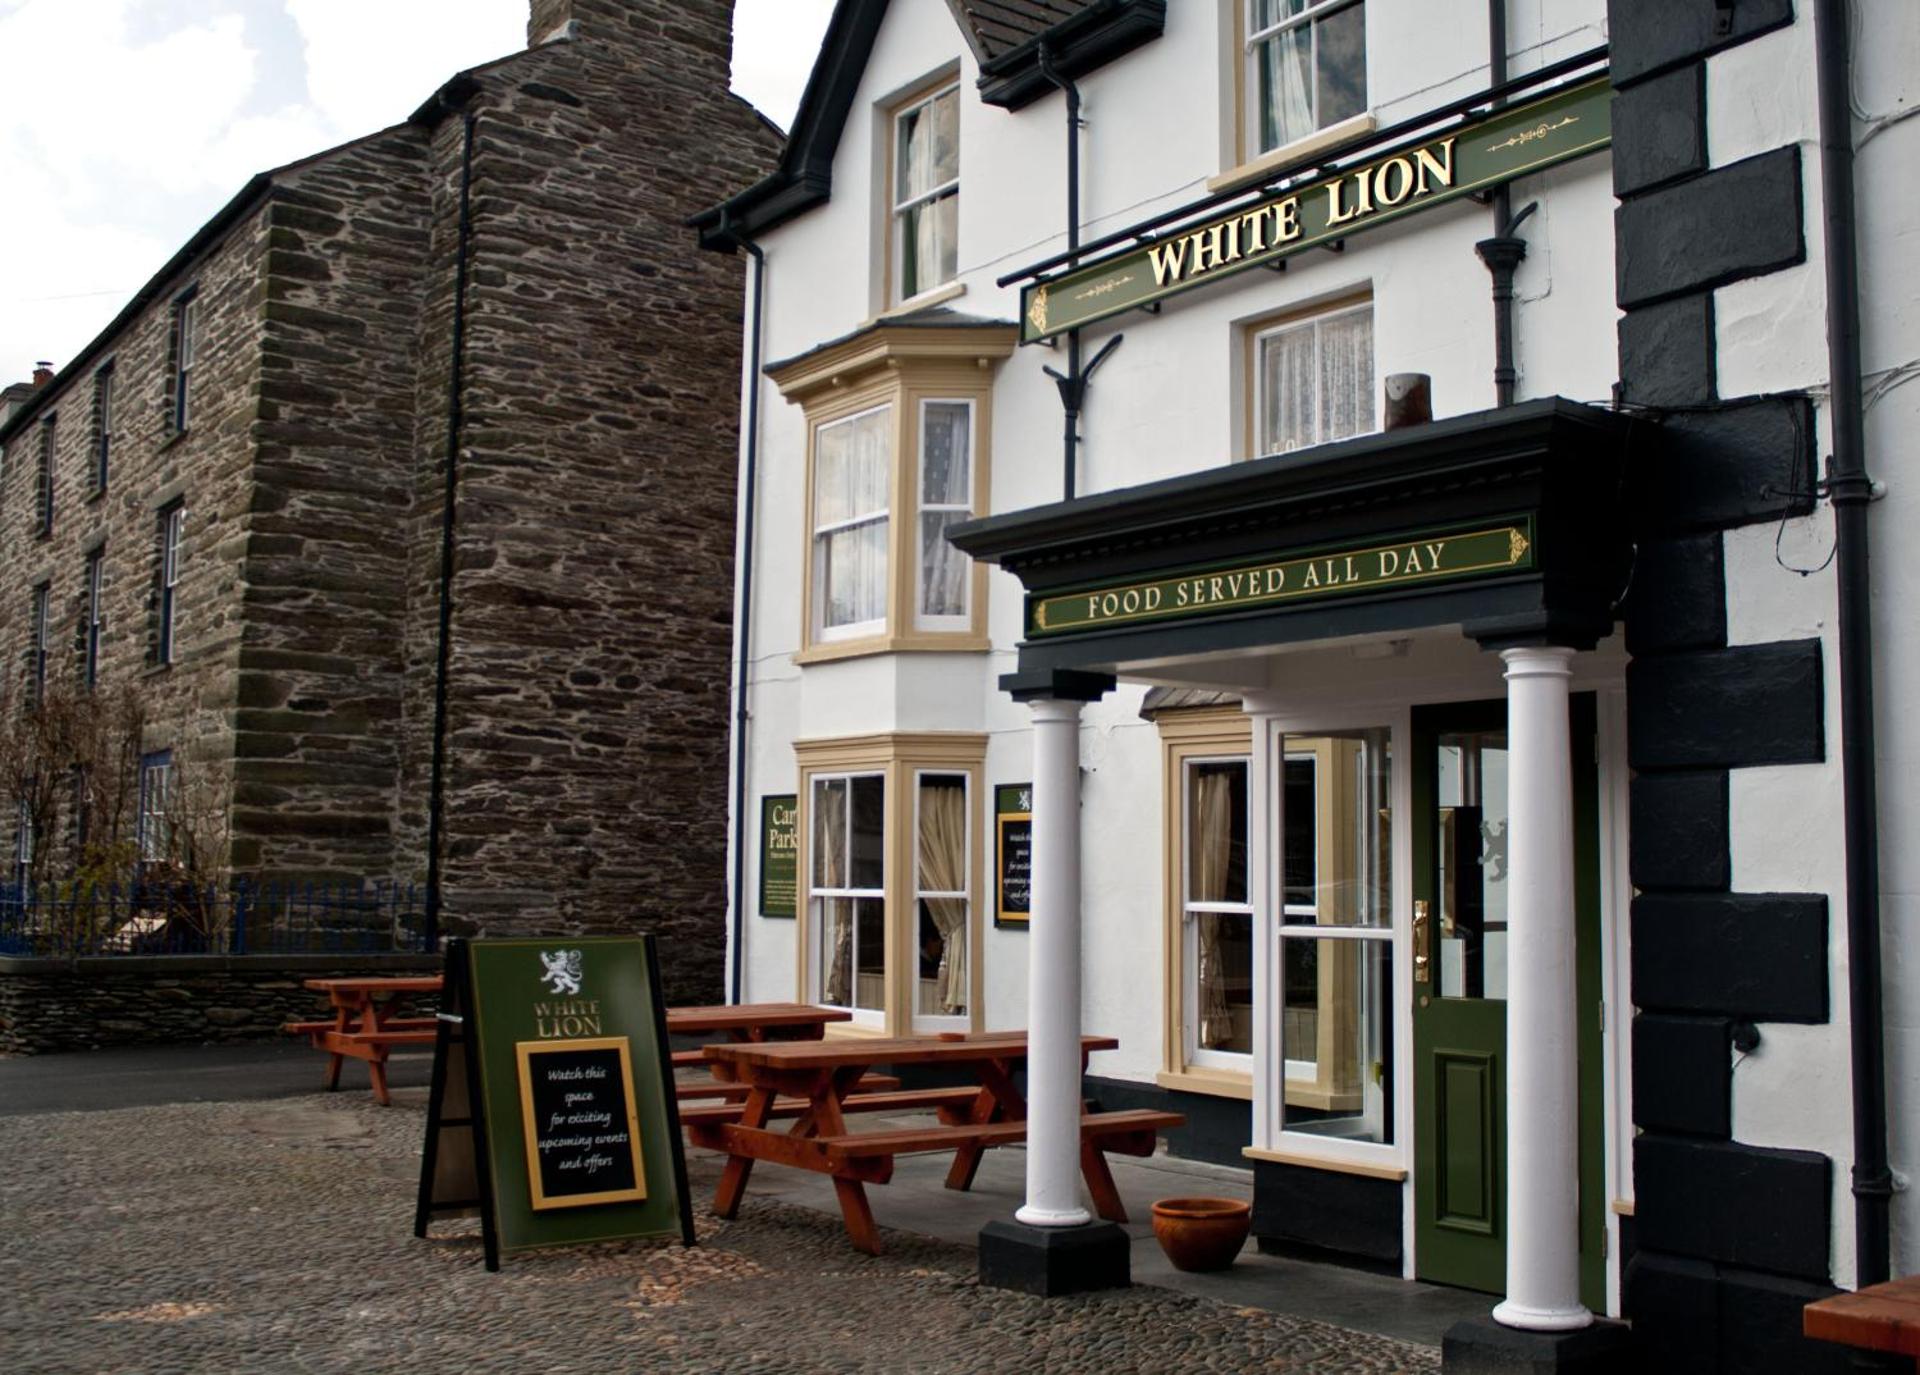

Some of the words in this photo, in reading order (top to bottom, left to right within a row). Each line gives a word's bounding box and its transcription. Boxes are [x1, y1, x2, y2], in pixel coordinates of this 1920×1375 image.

[1148, 196, 1300, 287] WHITE
[1325, 137, 1456, 227] LION
[1088, 586, 1162, 618] FOOD
[1177, 567, 1285, 606] SERVED
[1304, 556, 1359, 588] ALL
[1379, 543, 1445, 578] DAY
[533, 1000, 601, 1017] WHITE
[537, 1015, 602, 1038] LION
[547, 1066, 584, 1081] Watch
[584, 1065, 607, 1079] this
[564, 1092, 594, 1108] space
[547, 1112, 566, 1132] for
[567, 1110, 612, 1128] exciting
[538, 1134, 593, 1154] upcoming
[594, 1132, 628, 1144] events
[558, 1155, 582, 1170] and
[583, 1152, 613, 1174] offers
